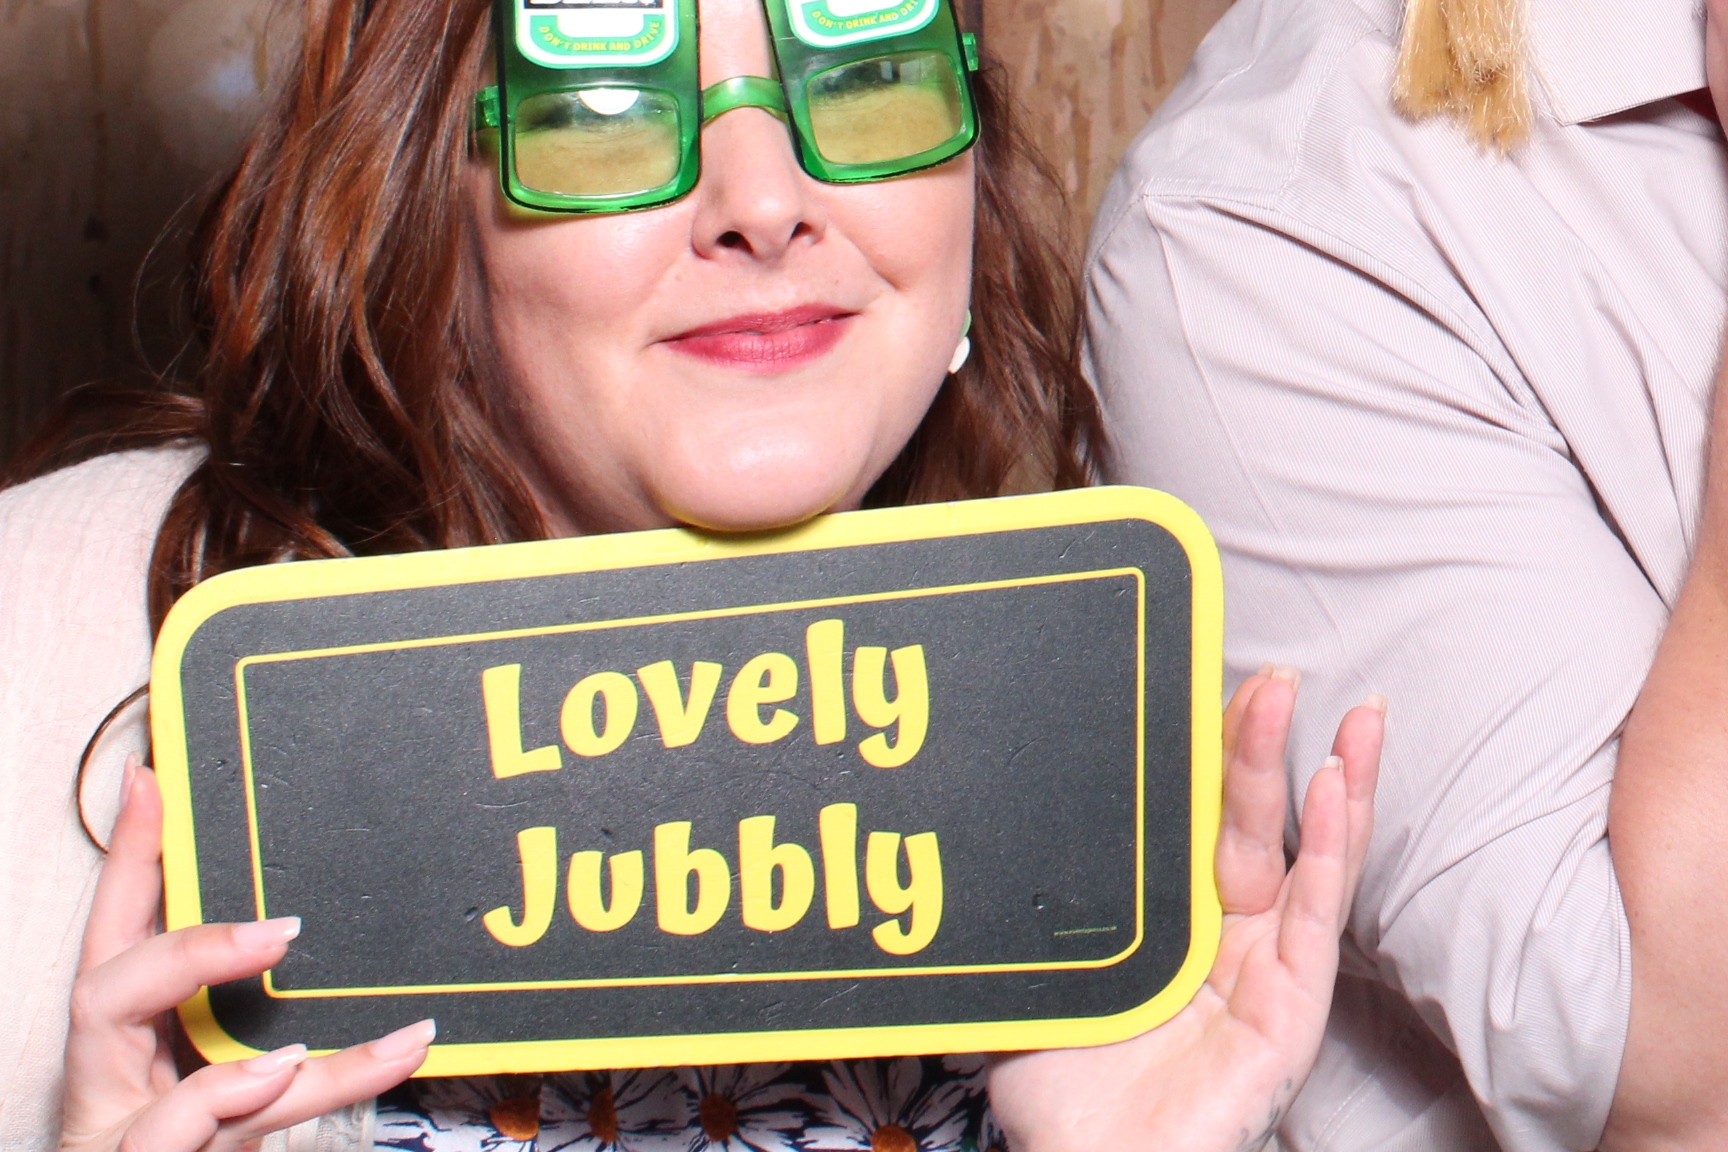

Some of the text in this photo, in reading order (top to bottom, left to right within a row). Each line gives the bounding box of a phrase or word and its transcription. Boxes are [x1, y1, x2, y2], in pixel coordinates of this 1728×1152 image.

[539, 21, 660, 51] DON'T DRINK AND DRIVE
[811, 10, 843, 29] DON'T
[846, 17, 877, 29] DRINK
[879, 11, 899, 22] AND
[482, 618, 930, 779] Lovely
[483, 802, 944, 955] Jubbly
